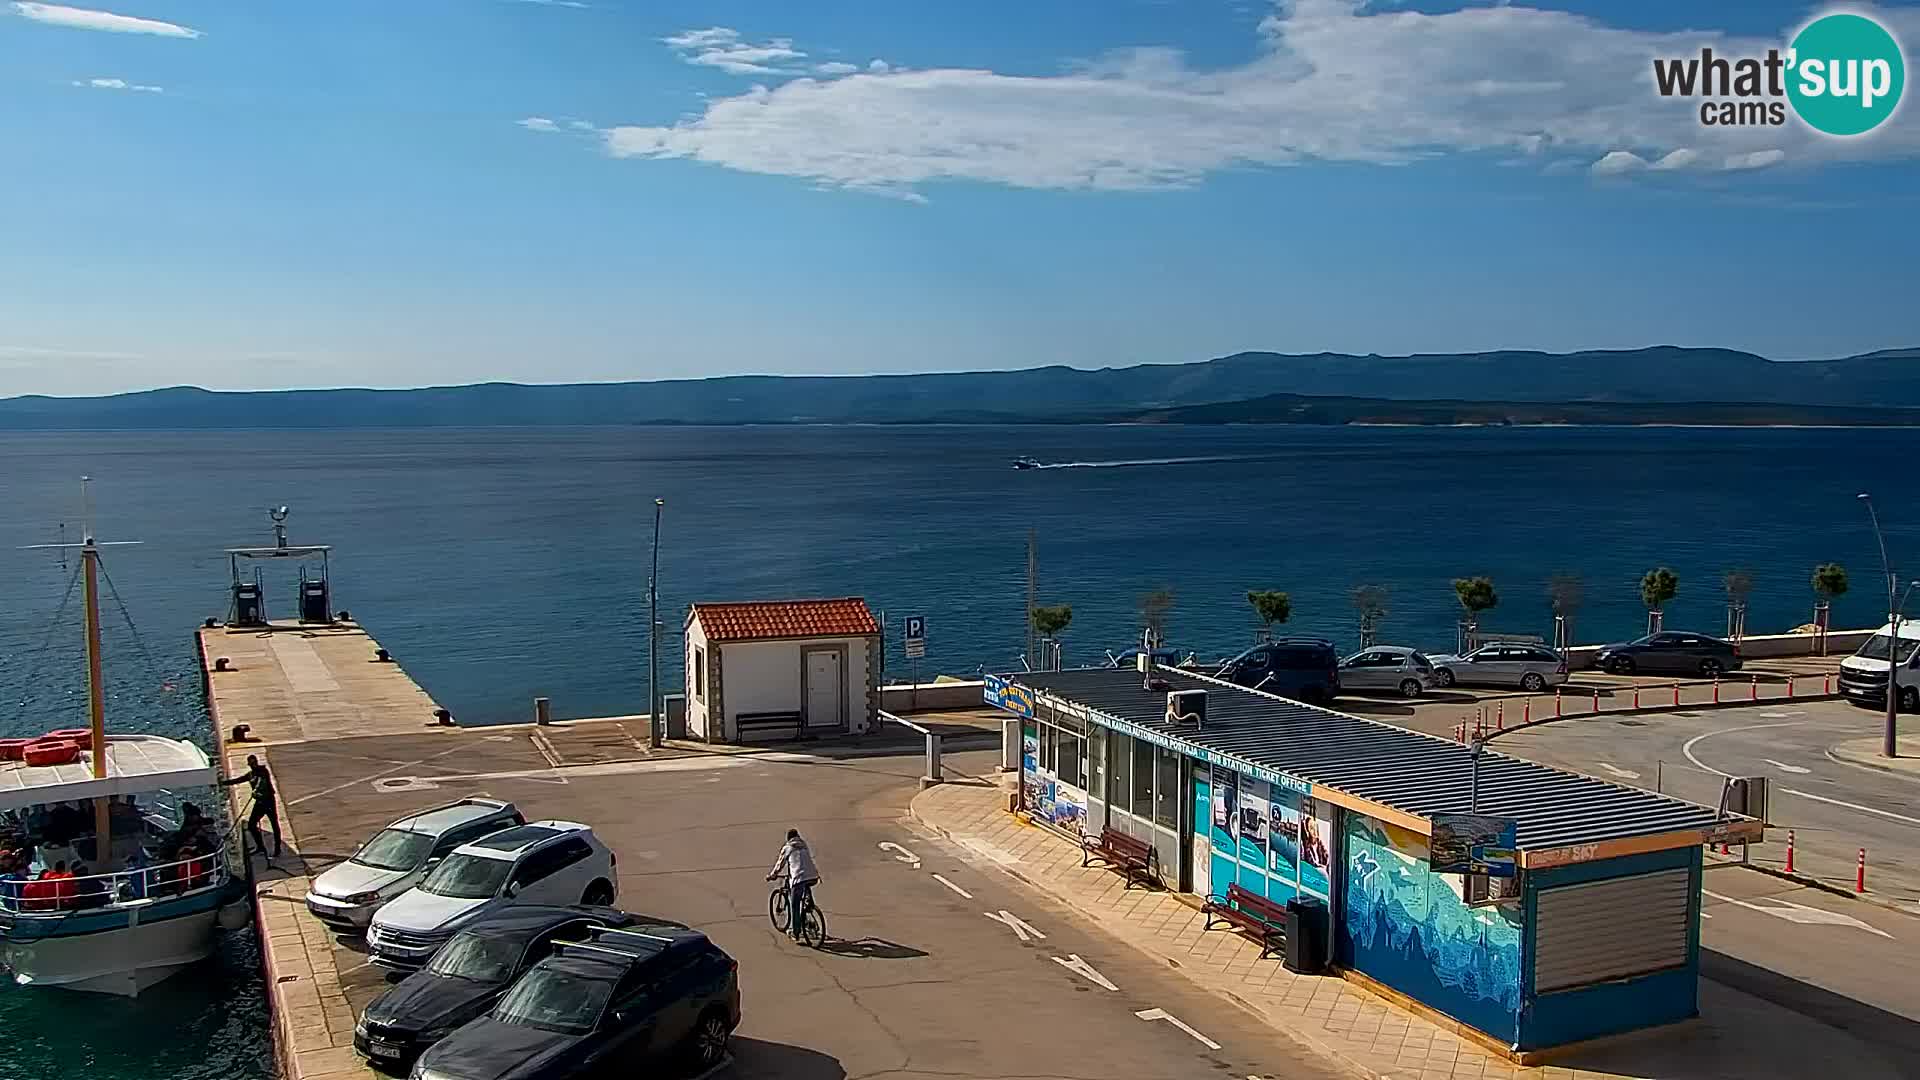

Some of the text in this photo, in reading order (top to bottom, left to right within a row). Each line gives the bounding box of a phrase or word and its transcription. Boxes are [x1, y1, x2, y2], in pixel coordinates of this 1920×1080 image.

[910, 620, 920, 636] P
[1132, 727, 1169, 747] AUTOBUSKA
[1169, 739, 1198, 757] POSTAJA
[1207, 752, 1221, 765] BUS
[1222, 757, 1253, 775] STATION
[1254, 766, 1280, 782] TICKET
[1280, 775, 1307, 792] OFFICE
